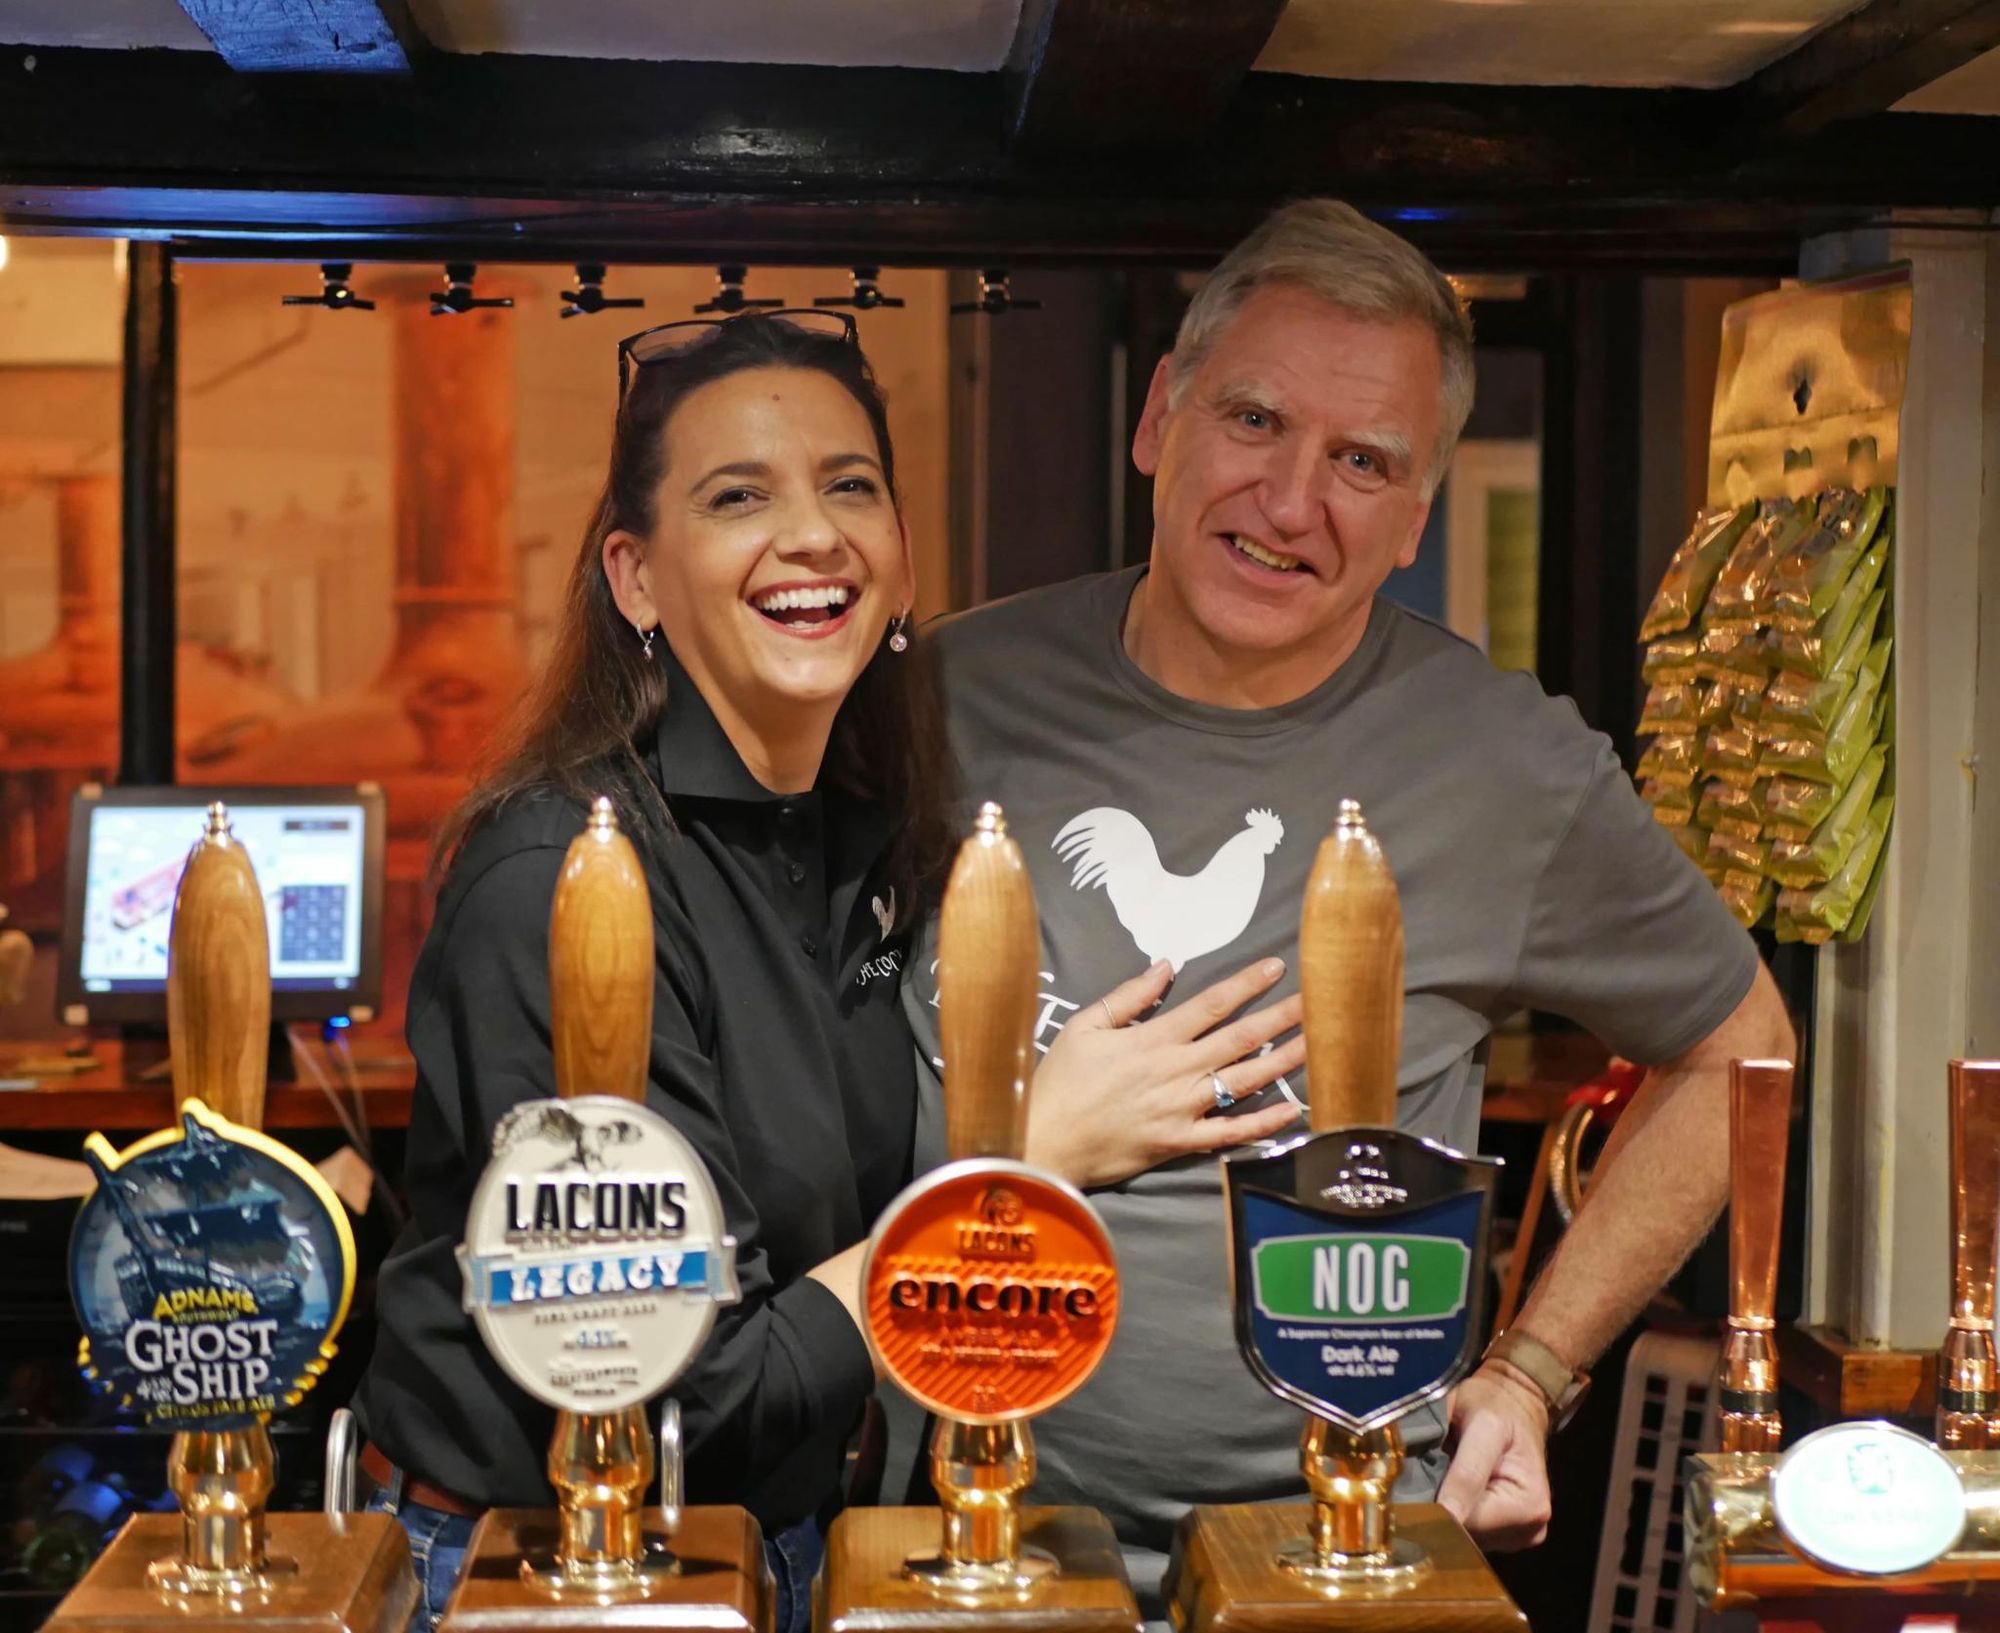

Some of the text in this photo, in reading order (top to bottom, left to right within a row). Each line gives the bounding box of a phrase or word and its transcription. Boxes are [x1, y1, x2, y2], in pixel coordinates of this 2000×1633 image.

[505, 1178, 687, 1234] LACONS
[957, 1230, 1035, 1251] LACONS
[510, 1251, 685, 1301] LEGACY
[888, 1274, 1099, 1318] encore
[1312, 1242, 1409, 1314] NOG
[153, 1286, 259, 1320] ADNAMS
[124, 1318, 279, 1372] GHOST
[1321, 1344, 1400, 1363] Dark Ale
[172, 1357, 270, 1405] SHIP
